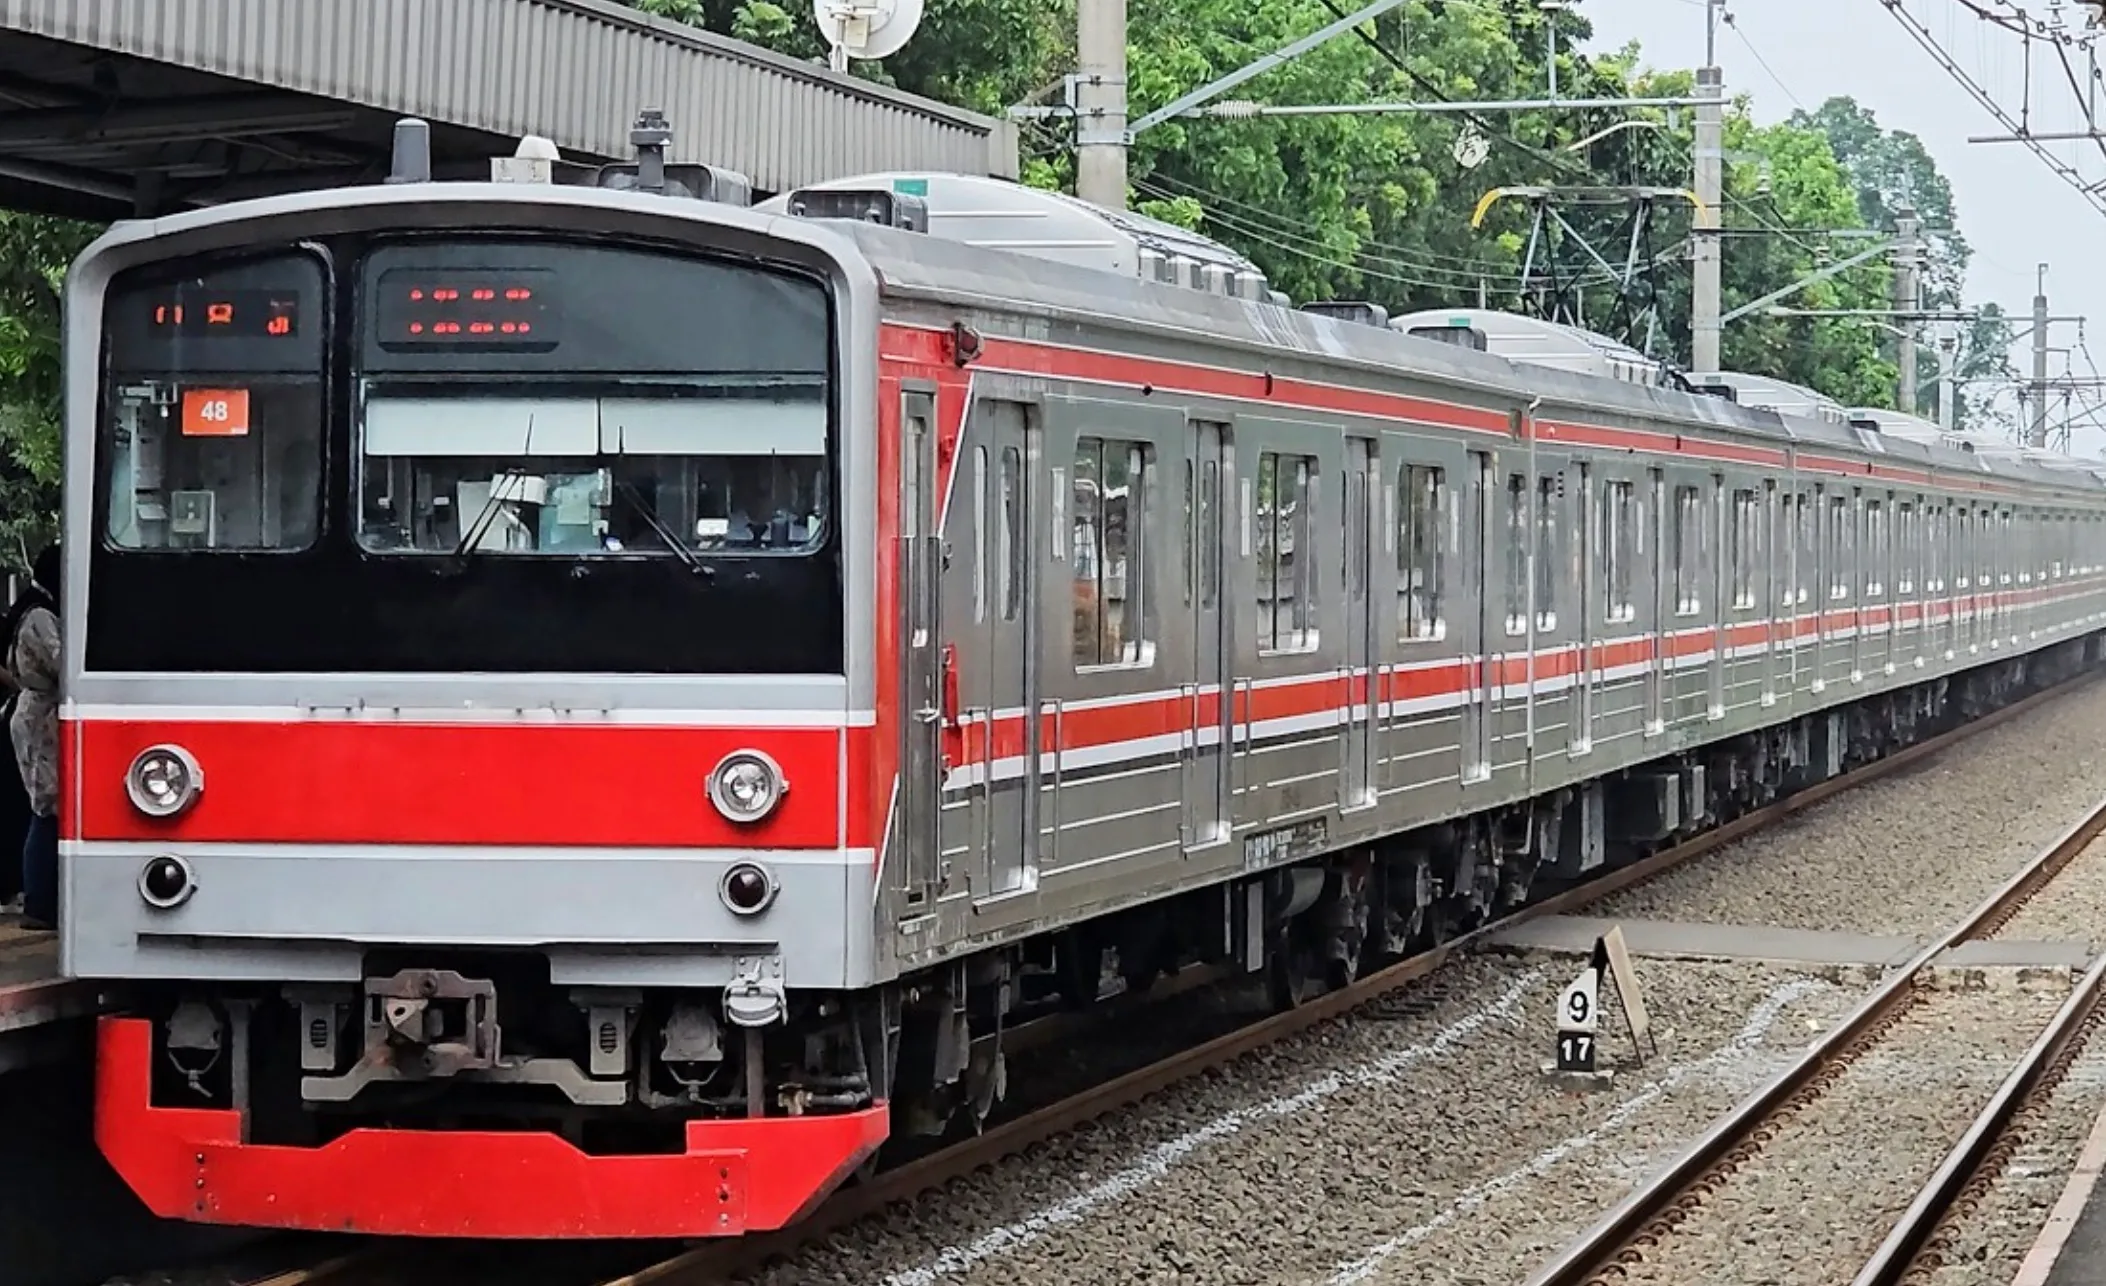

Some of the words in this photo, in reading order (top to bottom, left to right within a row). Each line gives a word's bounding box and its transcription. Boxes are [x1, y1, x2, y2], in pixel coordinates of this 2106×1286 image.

[201, 401, 228, 421] 48
[1569, 991, 1589, 1022] 9
[1562, 1037, 1591, 1061] 17
